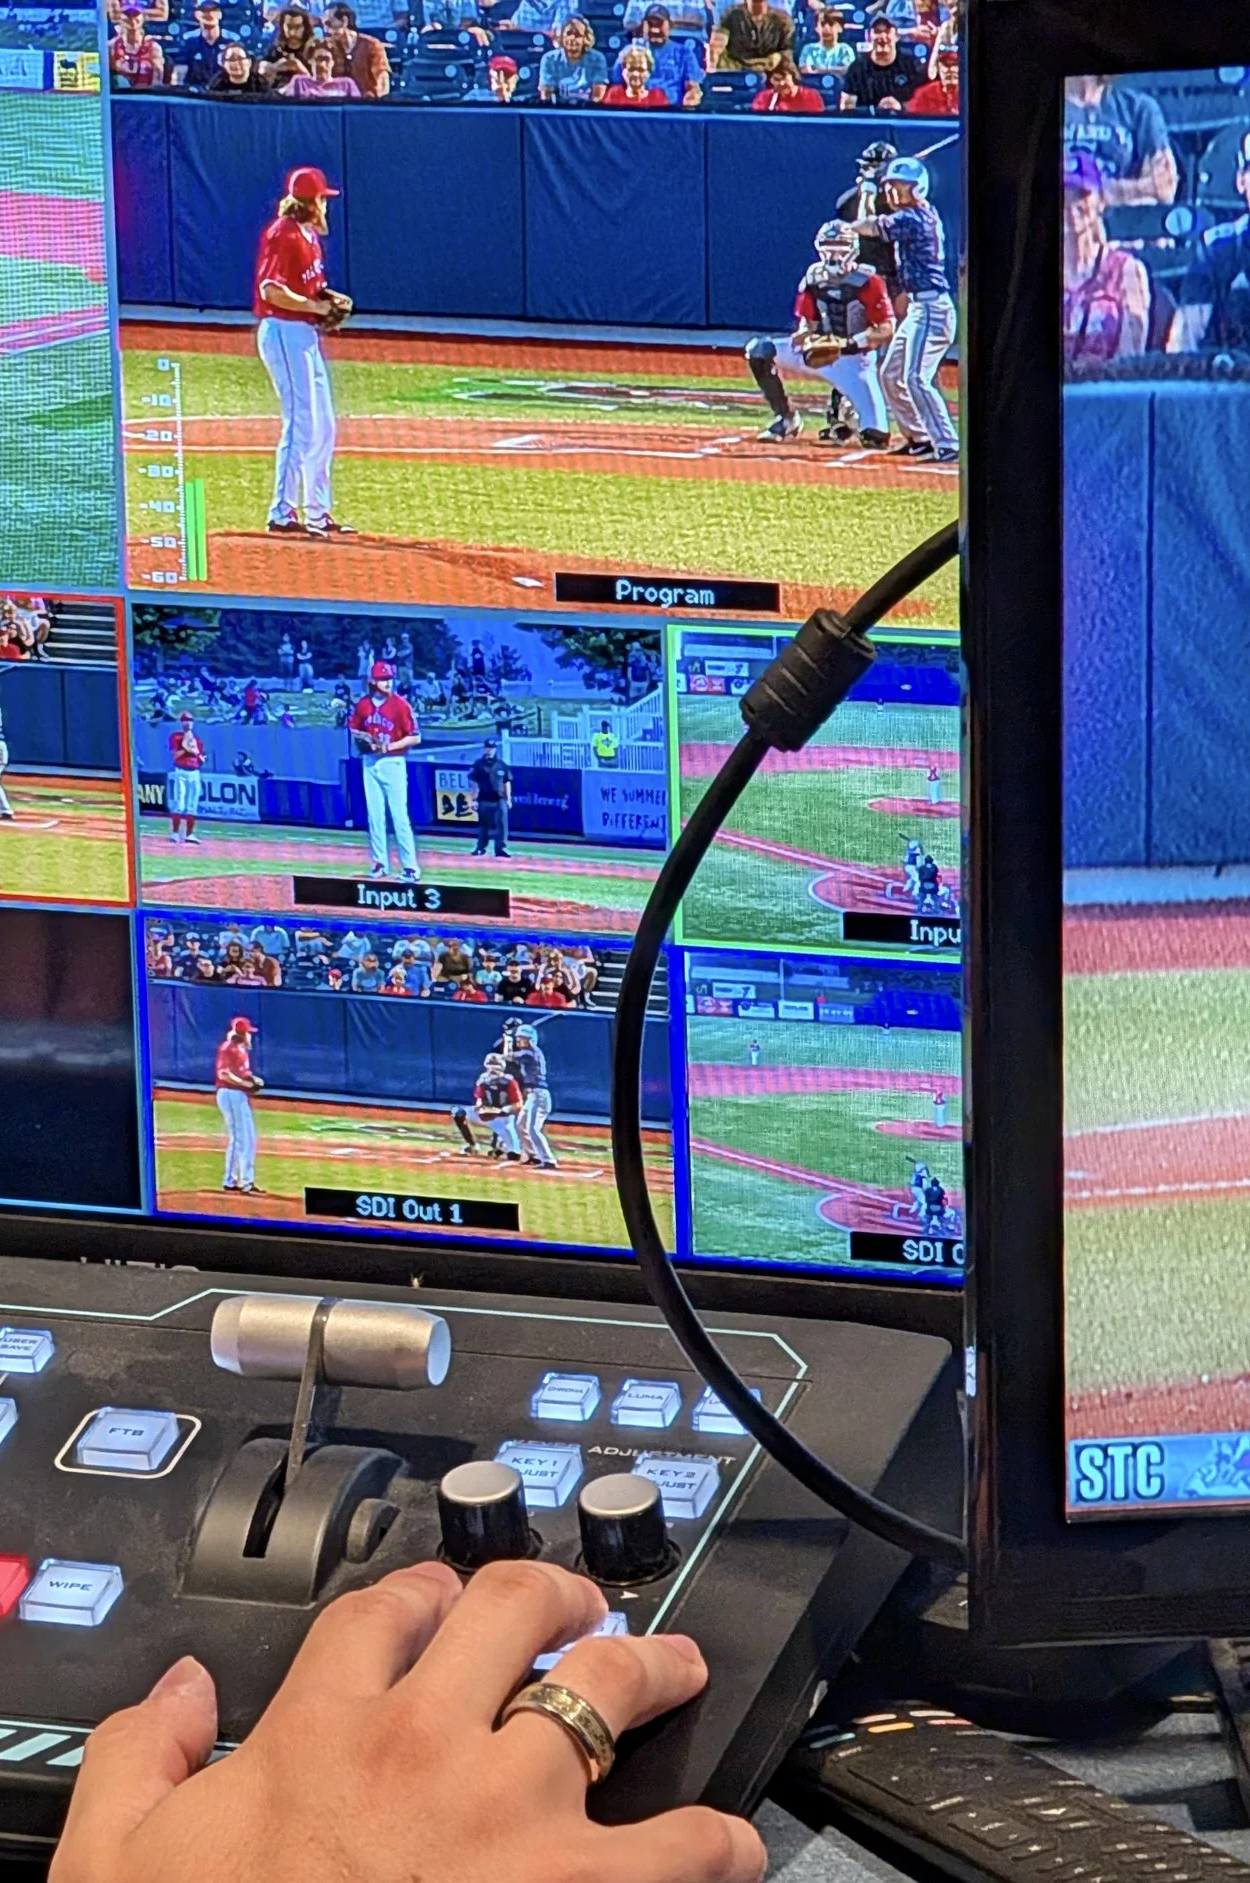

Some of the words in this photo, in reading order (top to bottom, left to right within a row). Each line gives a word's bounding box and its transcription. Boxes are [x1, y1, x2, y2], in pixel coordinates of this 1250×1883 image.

[615, 578, 716, 609] Program
[600, 787, 617, 804] WE
[356, 883, 418, 912] Input
[424, 887, 442, 910] 3
[910, 919, 962, 946] Inpu
[355, 1195, 396, 1218] SDI
[402, 1199, 443, 1223] Out
[449, 1203, 464, 1224] 1
[902, 1239, 944, 1263] SDI
[546, 1385, 585, 1395] CHROMA
[626, 1391, 665, 1402] LUMA
[108, 1426, 146, 1437] FTB
[511, 1456, 548, 1466] KEY
[523, 1468, 560, 1479] JUST
[646, 1468, 683, 1478] KEY
[1076, 1441, 1165, 1500] STC
[659, 1480, 698, 1490] JUST
[48, 1580, 94, 1591] WIPE
